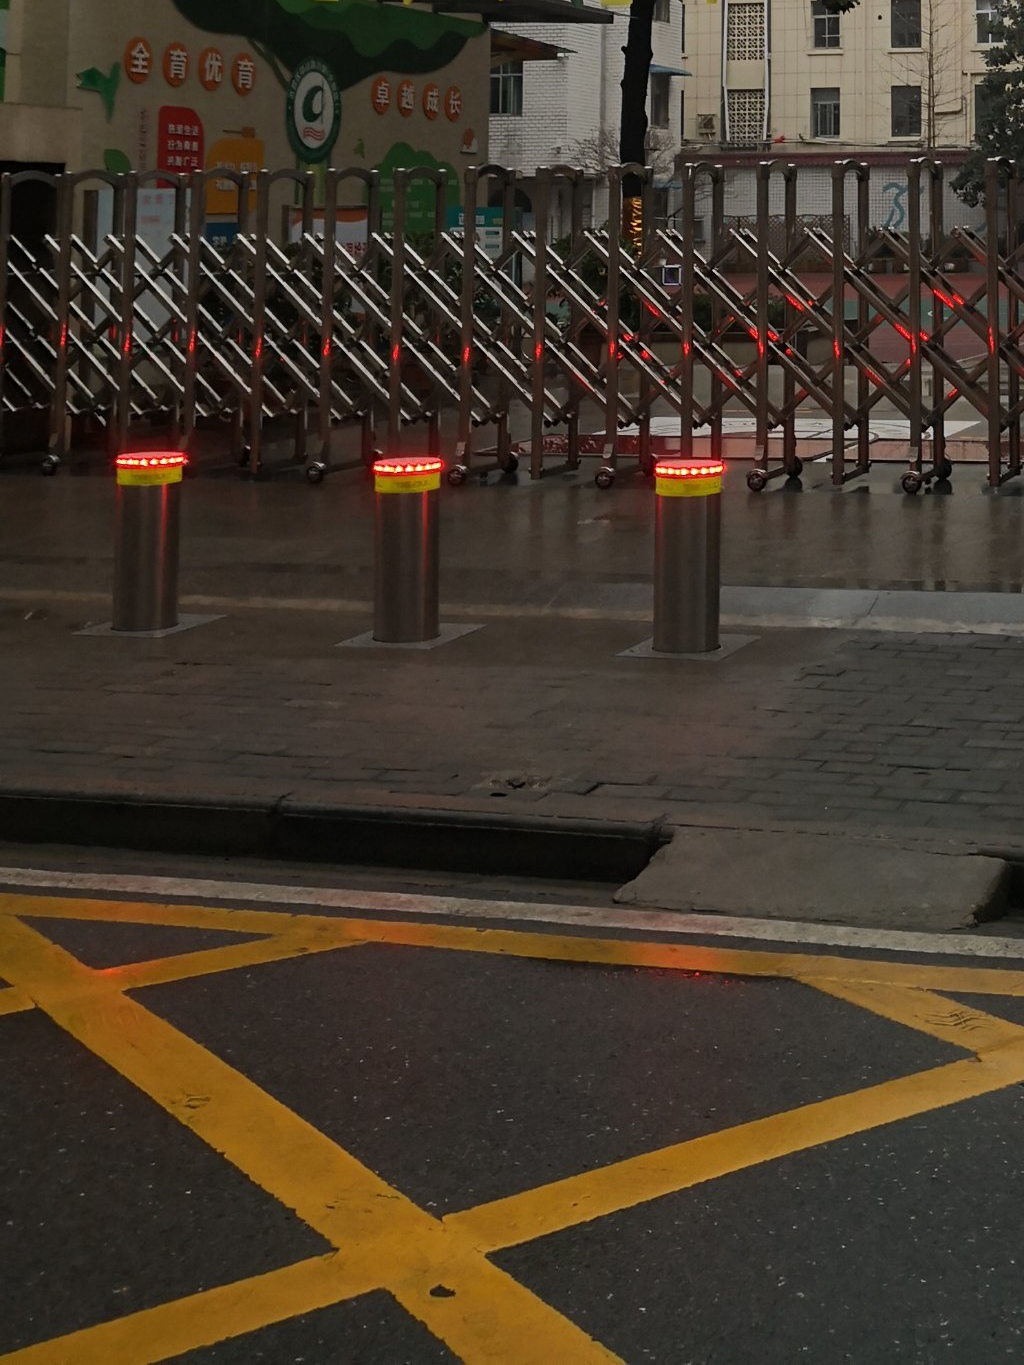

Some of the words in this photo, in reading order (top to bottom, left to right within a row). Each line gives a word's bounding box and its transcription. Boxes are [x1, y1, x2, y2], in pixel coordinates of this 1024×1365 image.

[129, 41, 255, 90] 全育优育
[375, 80, 462, 115] 卓越成长
